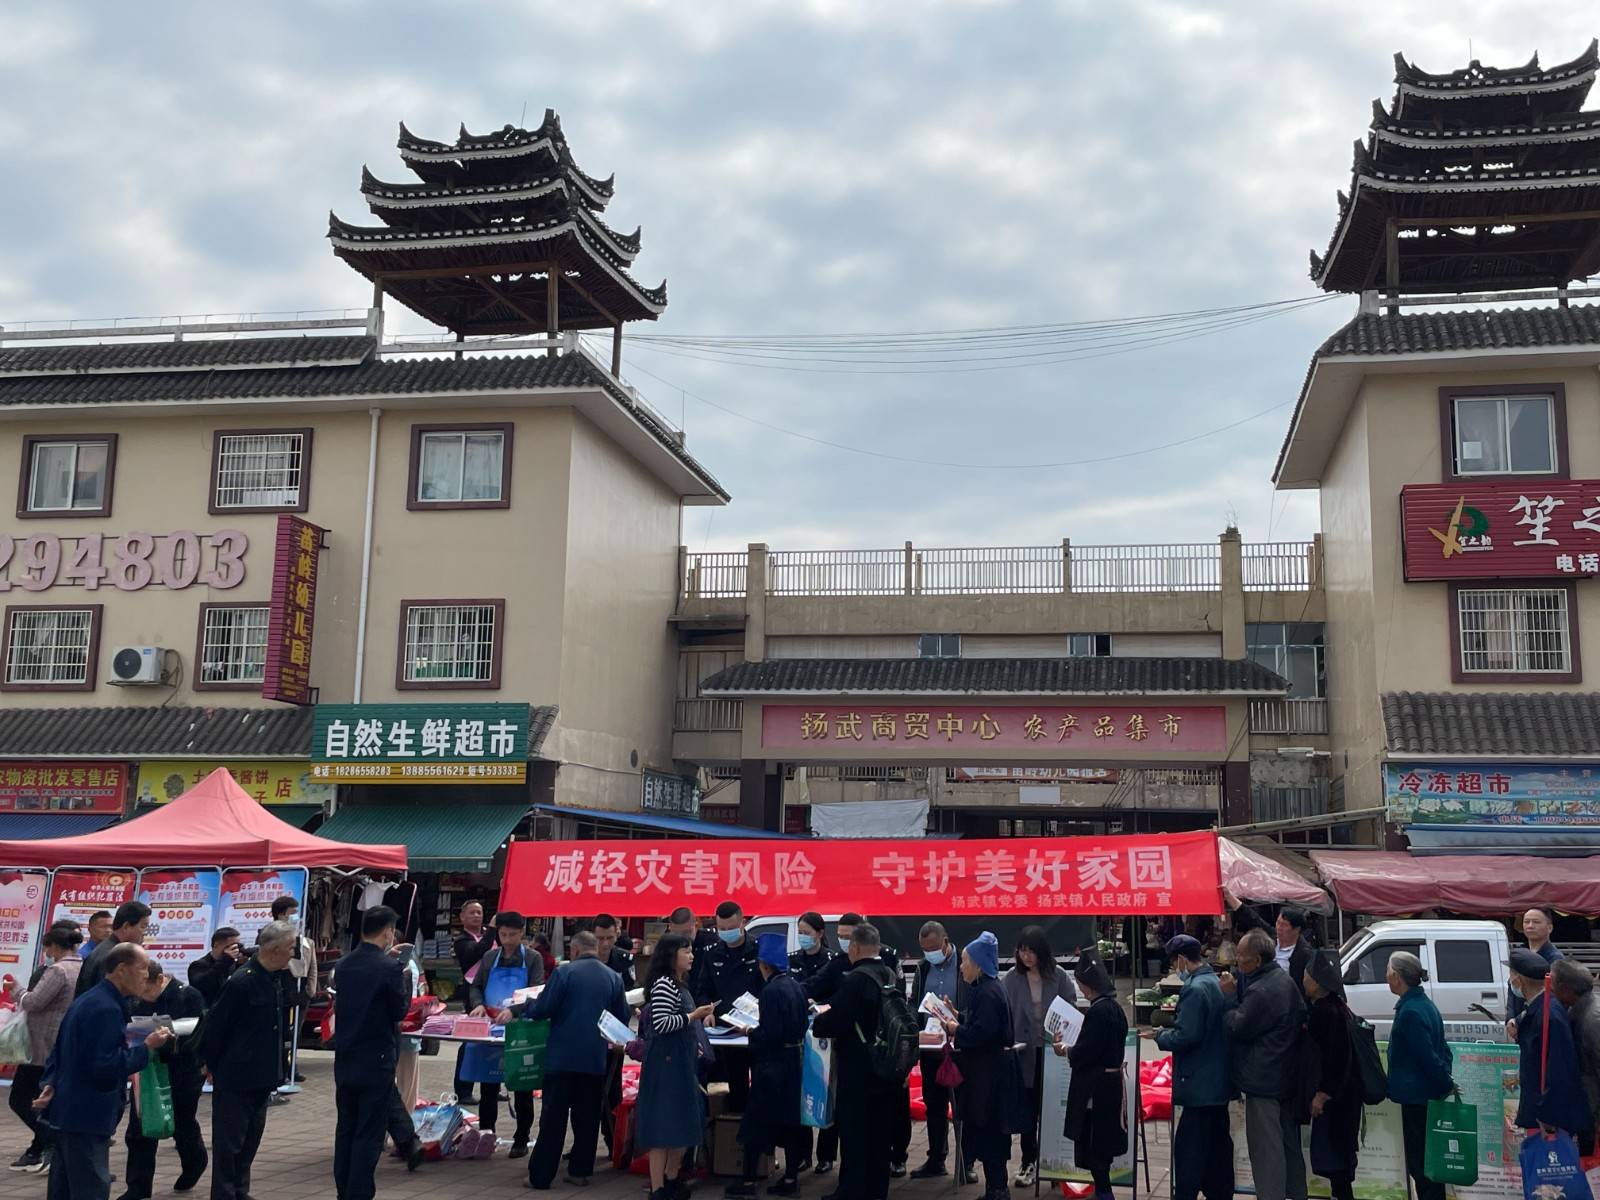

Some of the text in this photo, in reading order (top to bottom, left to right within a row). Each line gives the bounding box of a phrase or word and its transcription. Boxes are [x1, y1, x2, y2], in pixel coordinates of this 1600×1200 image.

[1556, 553, 1600, 573] 电话
[326, 718, 518, 757] 自然生鲜超市
[800, 711, 1183, 743] 扬武商贸中心 农产品集市
[192, 768, 269, 785] 土酱饼
[313, 765, 329, 777] 电话
[275, 777, 293, 798] 店
[1398, 771, 1512, 795] 冷冻超市
[543, 844, 1174, 895] 减轻灾害风险 守护美好家园
[952, 892, 1173, 909] 扬武镇党委 扬武镇人民政府 宣
